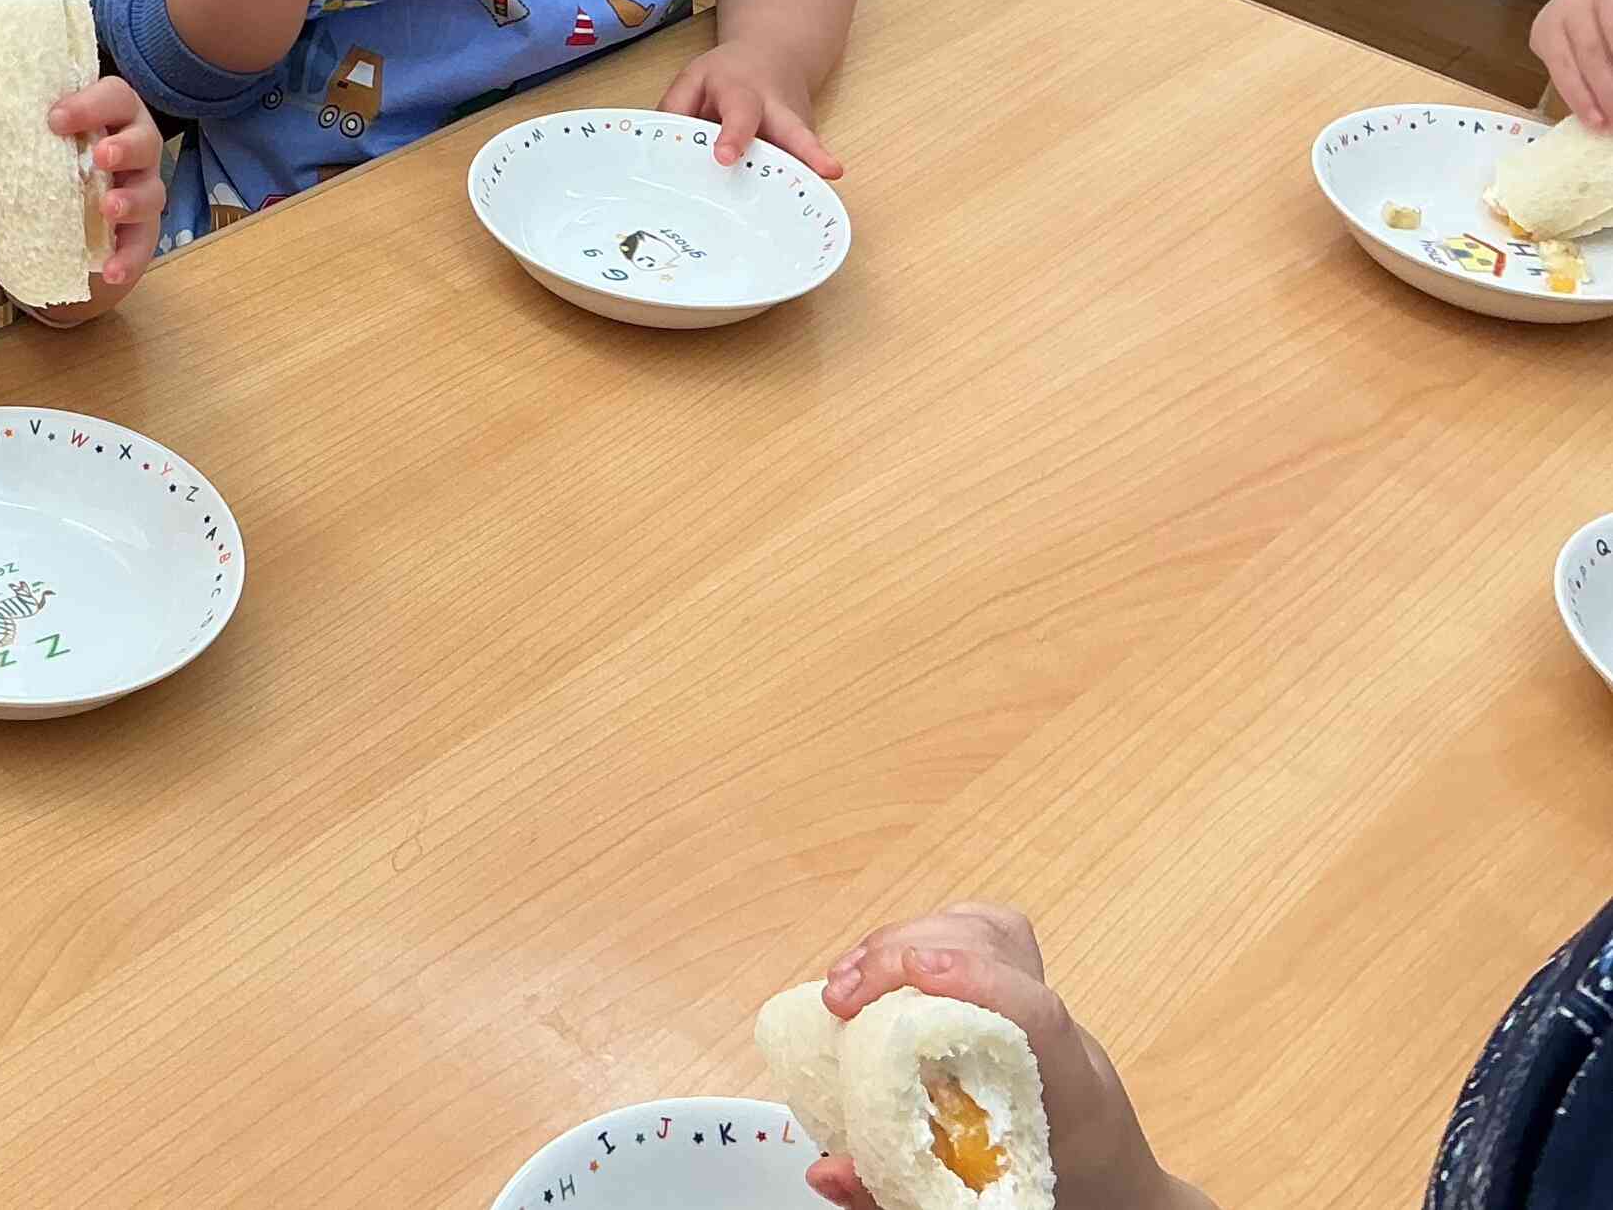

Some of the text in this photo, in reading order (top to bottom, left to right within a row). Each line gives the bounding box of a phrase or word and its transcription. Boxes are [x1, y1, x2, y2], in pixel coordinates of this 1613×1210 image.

[1363, 120, 1375, 136] X
[1422, 110, 1437, 124] Z
[1474, 121, 1486, 134] A
[532, 129, 545, 143] M
[581, 122, 596, 138] N
[653, 129, 664, 141] P
[693, 131, 708, 146] Q
[760, 165, 772, 177] S
[659, 228, 707, 259] ghost
[29, 419, 42, 435] V
[71, 429, 90, 447] W
[119, 444, 132, 460] X
[160, 461, 173, 475] Y
[186, 485, 199, 502] Z
[205, 526, 218, 541] A
[1596, 538, 1612, 557] Q
[35, 633, 72, 659] Z
[559, 1117, 796, 1201] H I J K L
